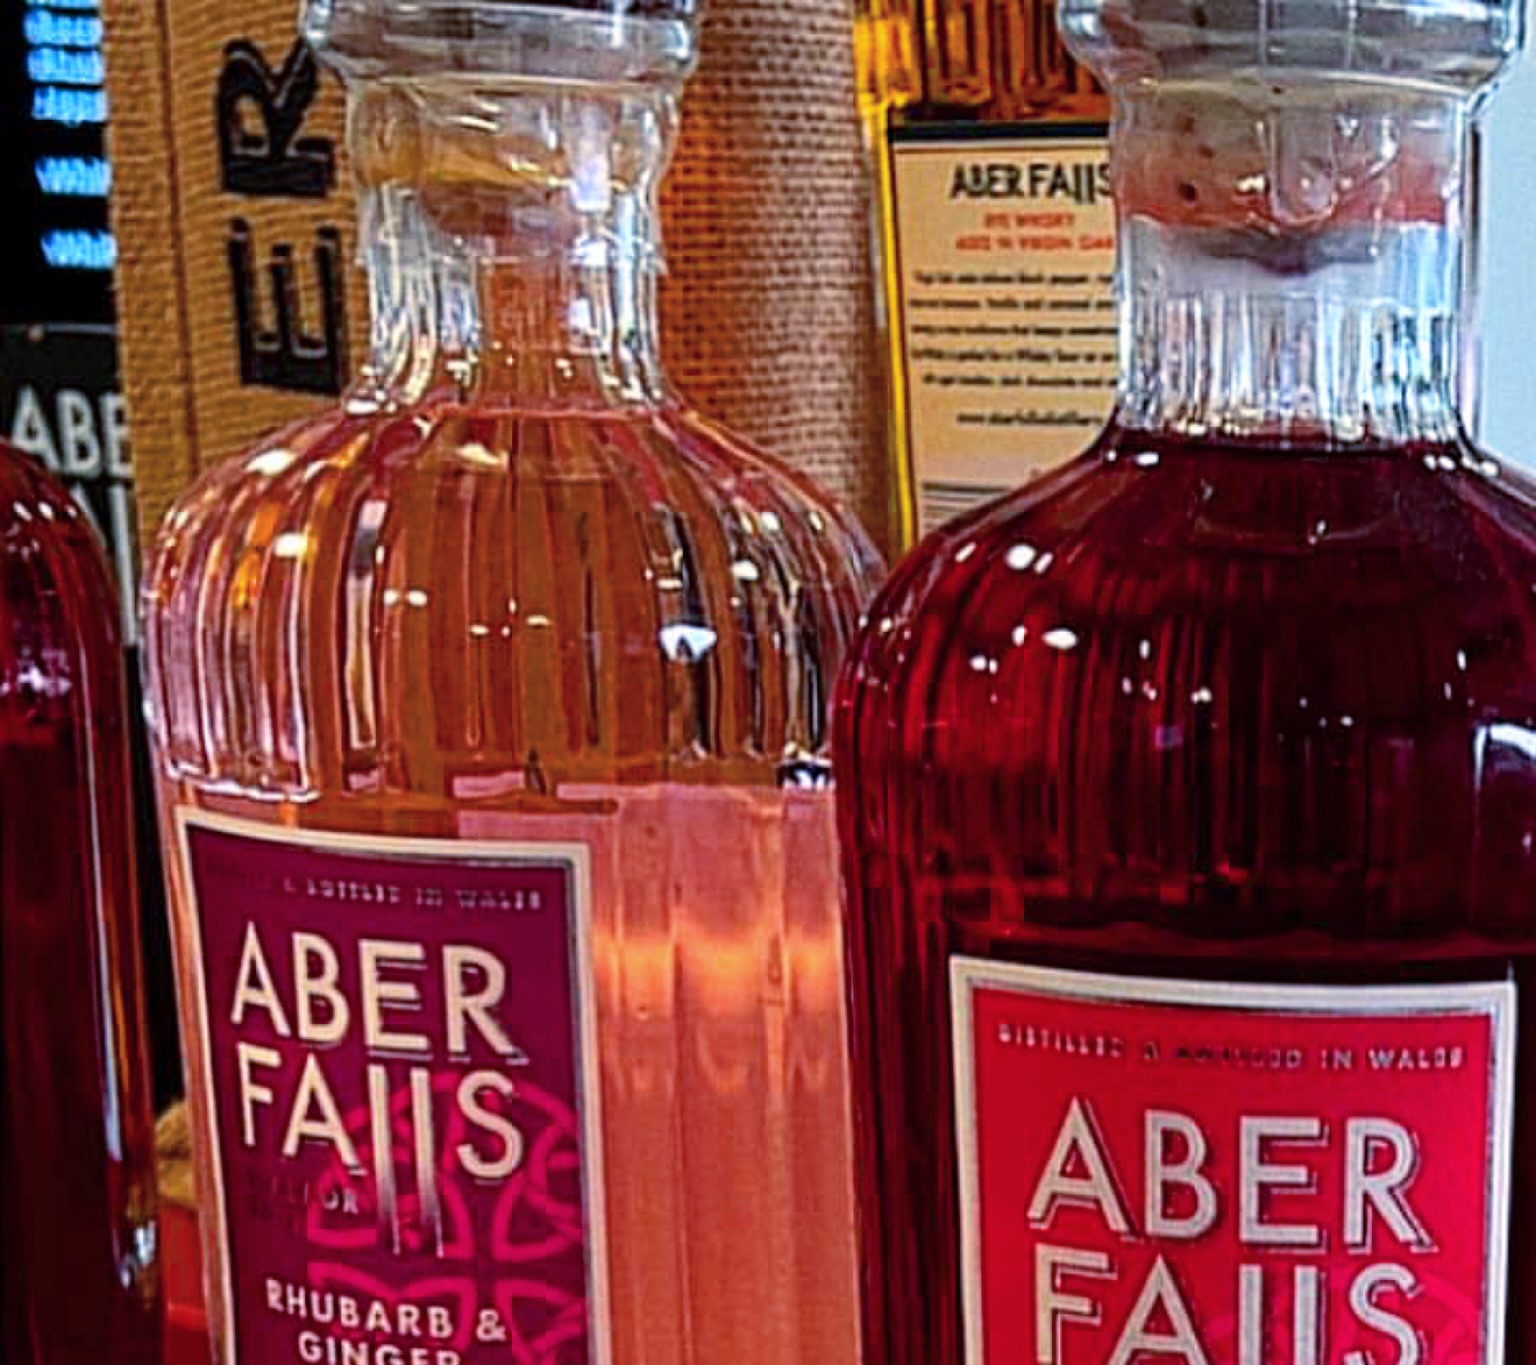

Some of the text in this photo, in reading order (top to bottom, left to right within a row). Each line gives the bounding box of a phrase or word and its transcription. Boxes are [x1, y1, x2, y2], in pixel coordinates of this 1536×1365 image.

[231, 920, 530, 1062] ABER
[1322, 1049, 1353, 1070] IN
[1027, 1095, 1438, 1253] ABER
[265, 1278, 507, 1342] RHUBARB &
